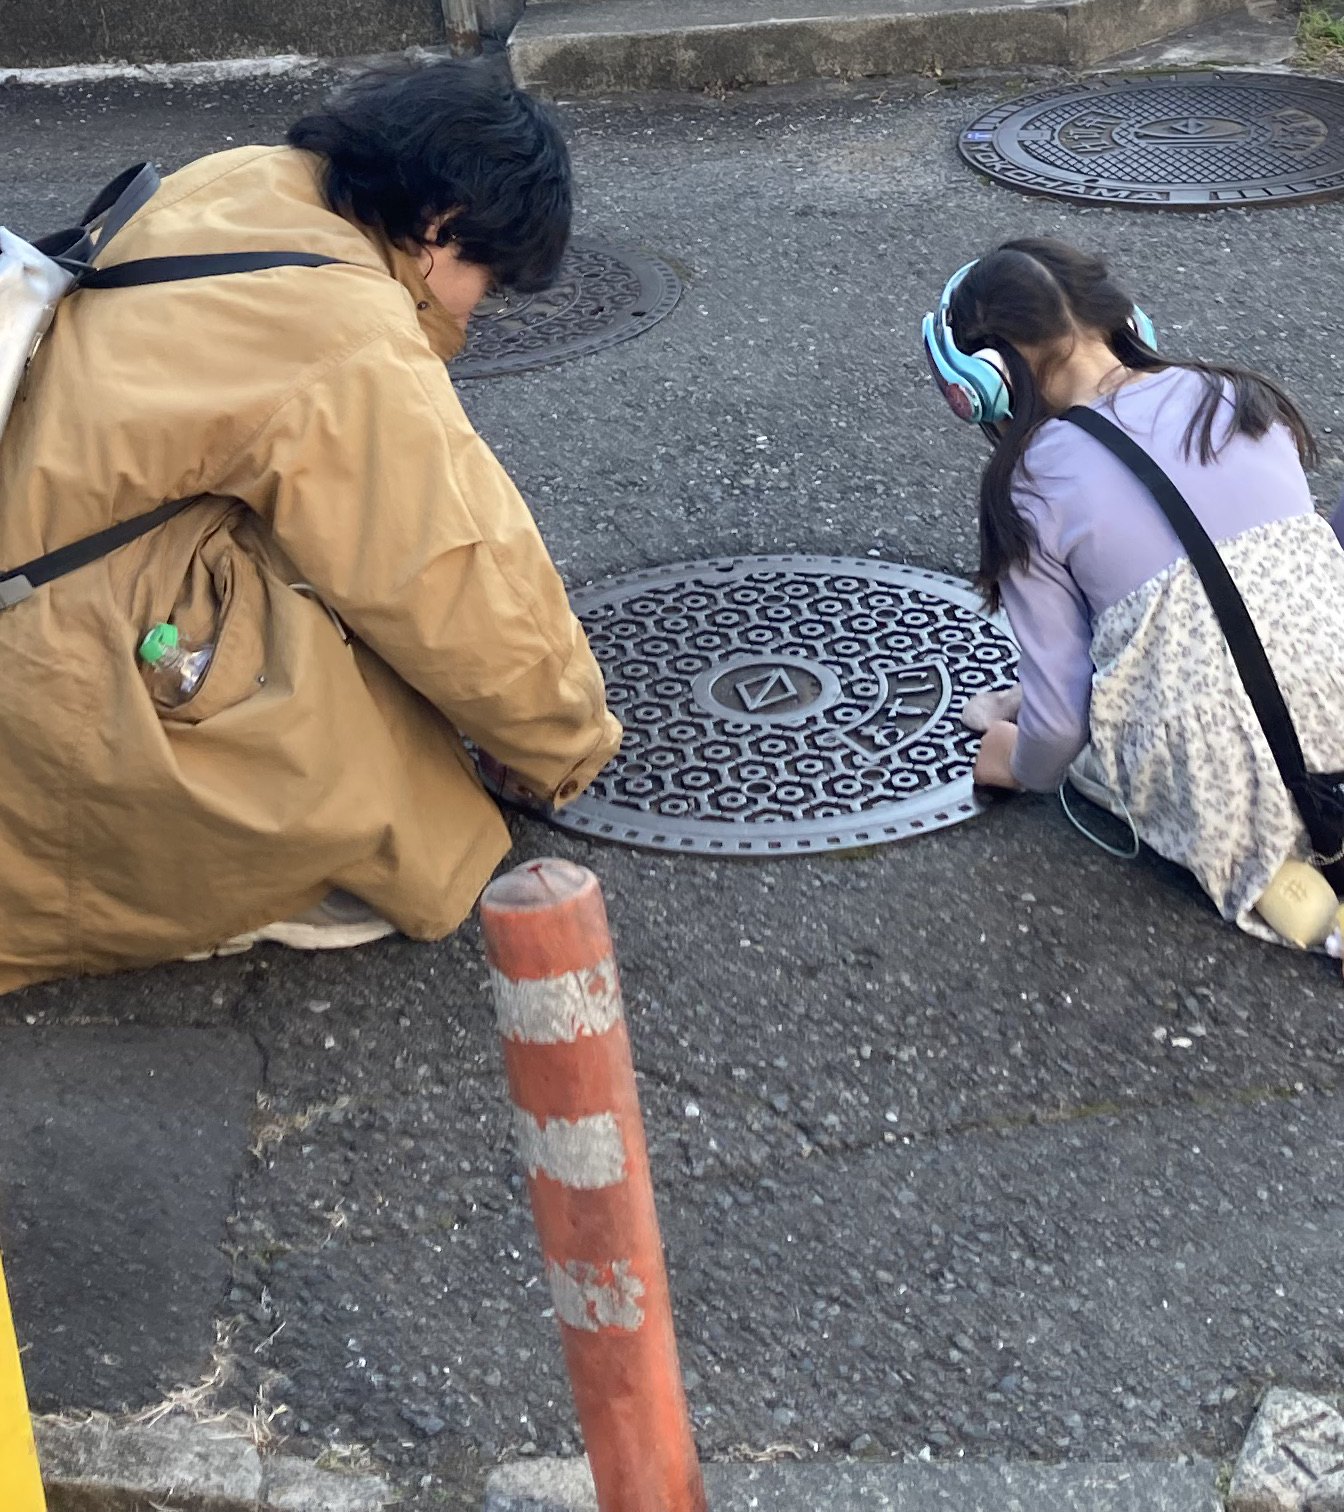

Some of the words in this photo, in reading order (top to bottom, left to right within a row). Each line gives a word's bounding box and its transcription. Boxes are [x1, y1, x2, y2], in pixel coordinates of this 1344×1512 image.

[968, 141, 1164, 201] YOKOHAMA
[856, 671, 936, 747] おすい
